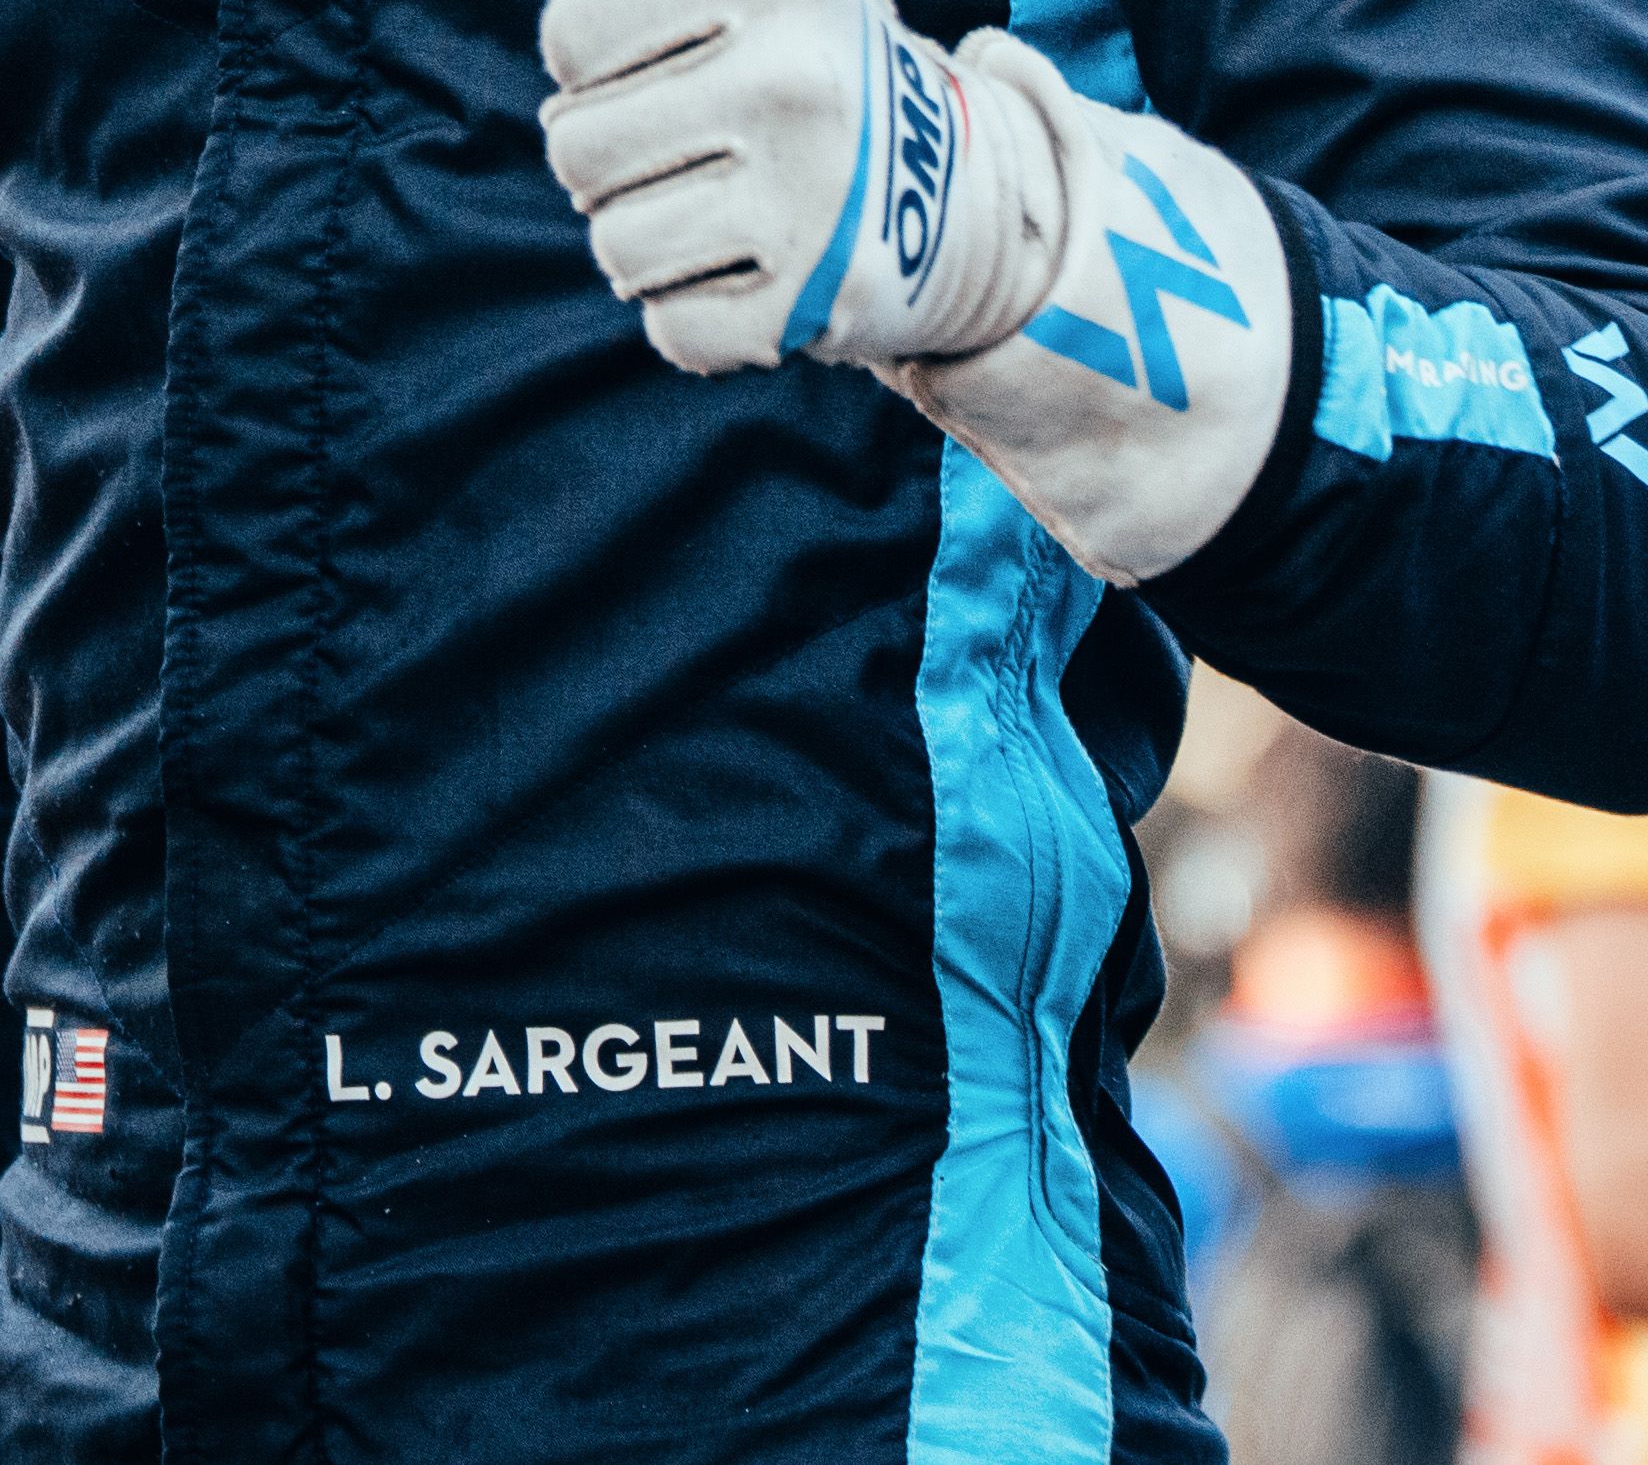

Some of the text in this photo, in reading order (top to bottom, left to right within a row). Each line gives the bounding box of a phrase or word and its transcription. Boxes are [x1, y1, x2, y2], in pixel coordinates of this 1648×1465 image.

[897, 42, 942, 278] OMP
[325, 1015, 886, 1102] L. SARGEANT
